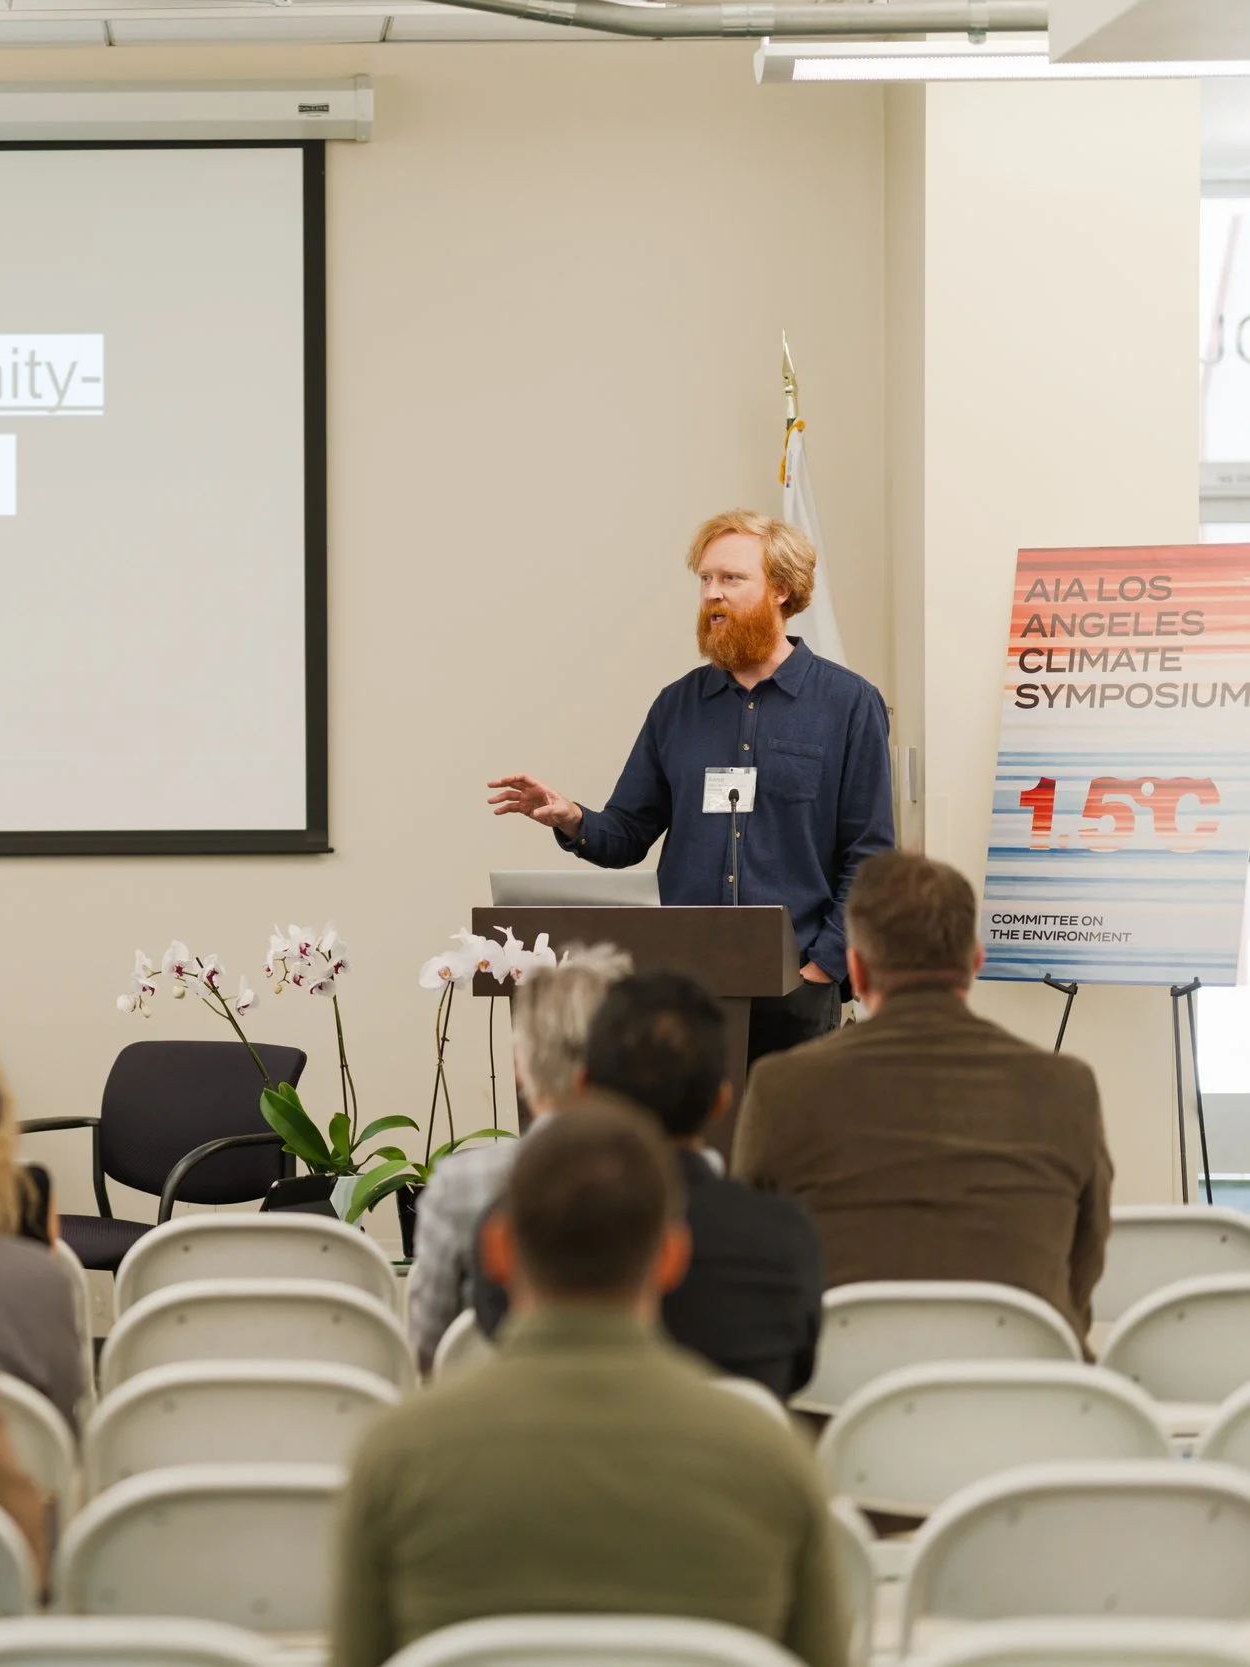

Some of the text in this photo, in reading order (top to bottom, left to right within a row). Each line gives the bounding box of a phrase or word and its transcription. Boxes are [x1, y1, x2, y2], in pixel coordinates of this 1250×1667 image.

[1024, 575, 1172, 602] AIA LOS
[1020, 610, 1205, 638] ANGELES
[1018, 647, 1184, 673] CLIMATE
[1014, 682, 1250, 709] SYMPOSIUM
[991, 913, 1103, 926] COMMITTEE ON
[990, 929, 1132, 942] THE ENVIRONMENT
